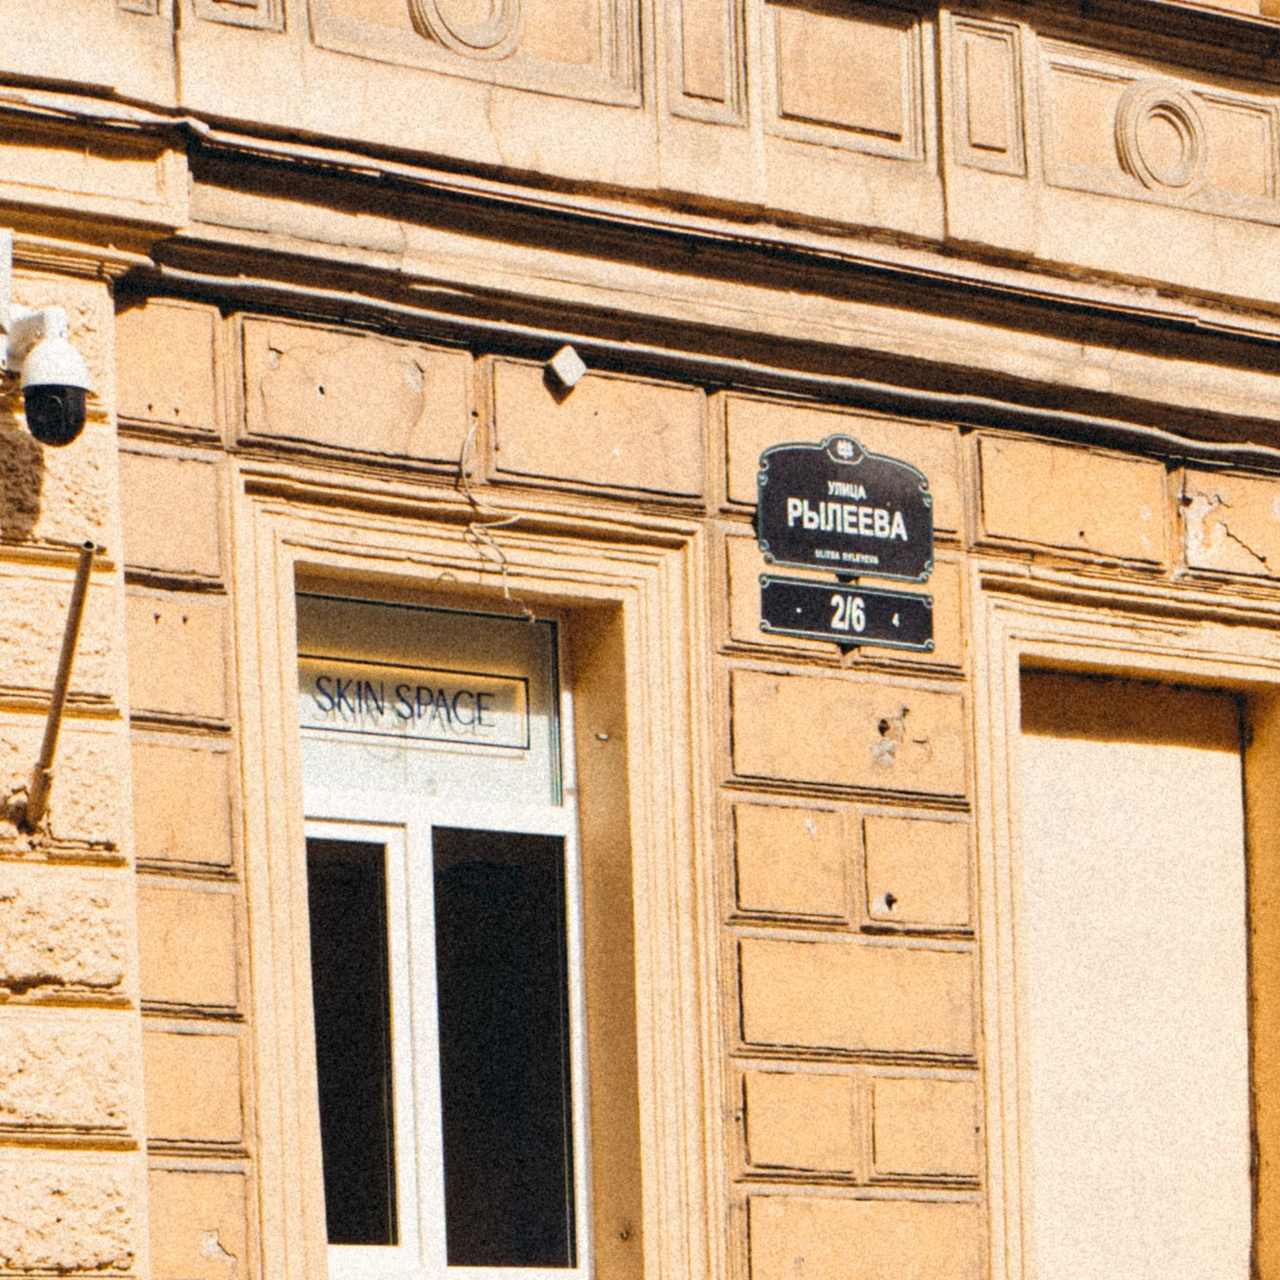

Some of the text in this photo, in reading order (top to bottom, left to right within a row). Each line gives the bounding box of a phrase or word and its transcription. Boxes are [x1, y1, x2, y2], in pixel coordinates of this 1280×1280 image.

[827, 480, 867, 500] УЛИЦА
[787, 498, 908, 541] РЫЛЕЕВА
[830, 595, 866, 632] 2/6
[315, 675, 496, 728] SKIN SPACE
